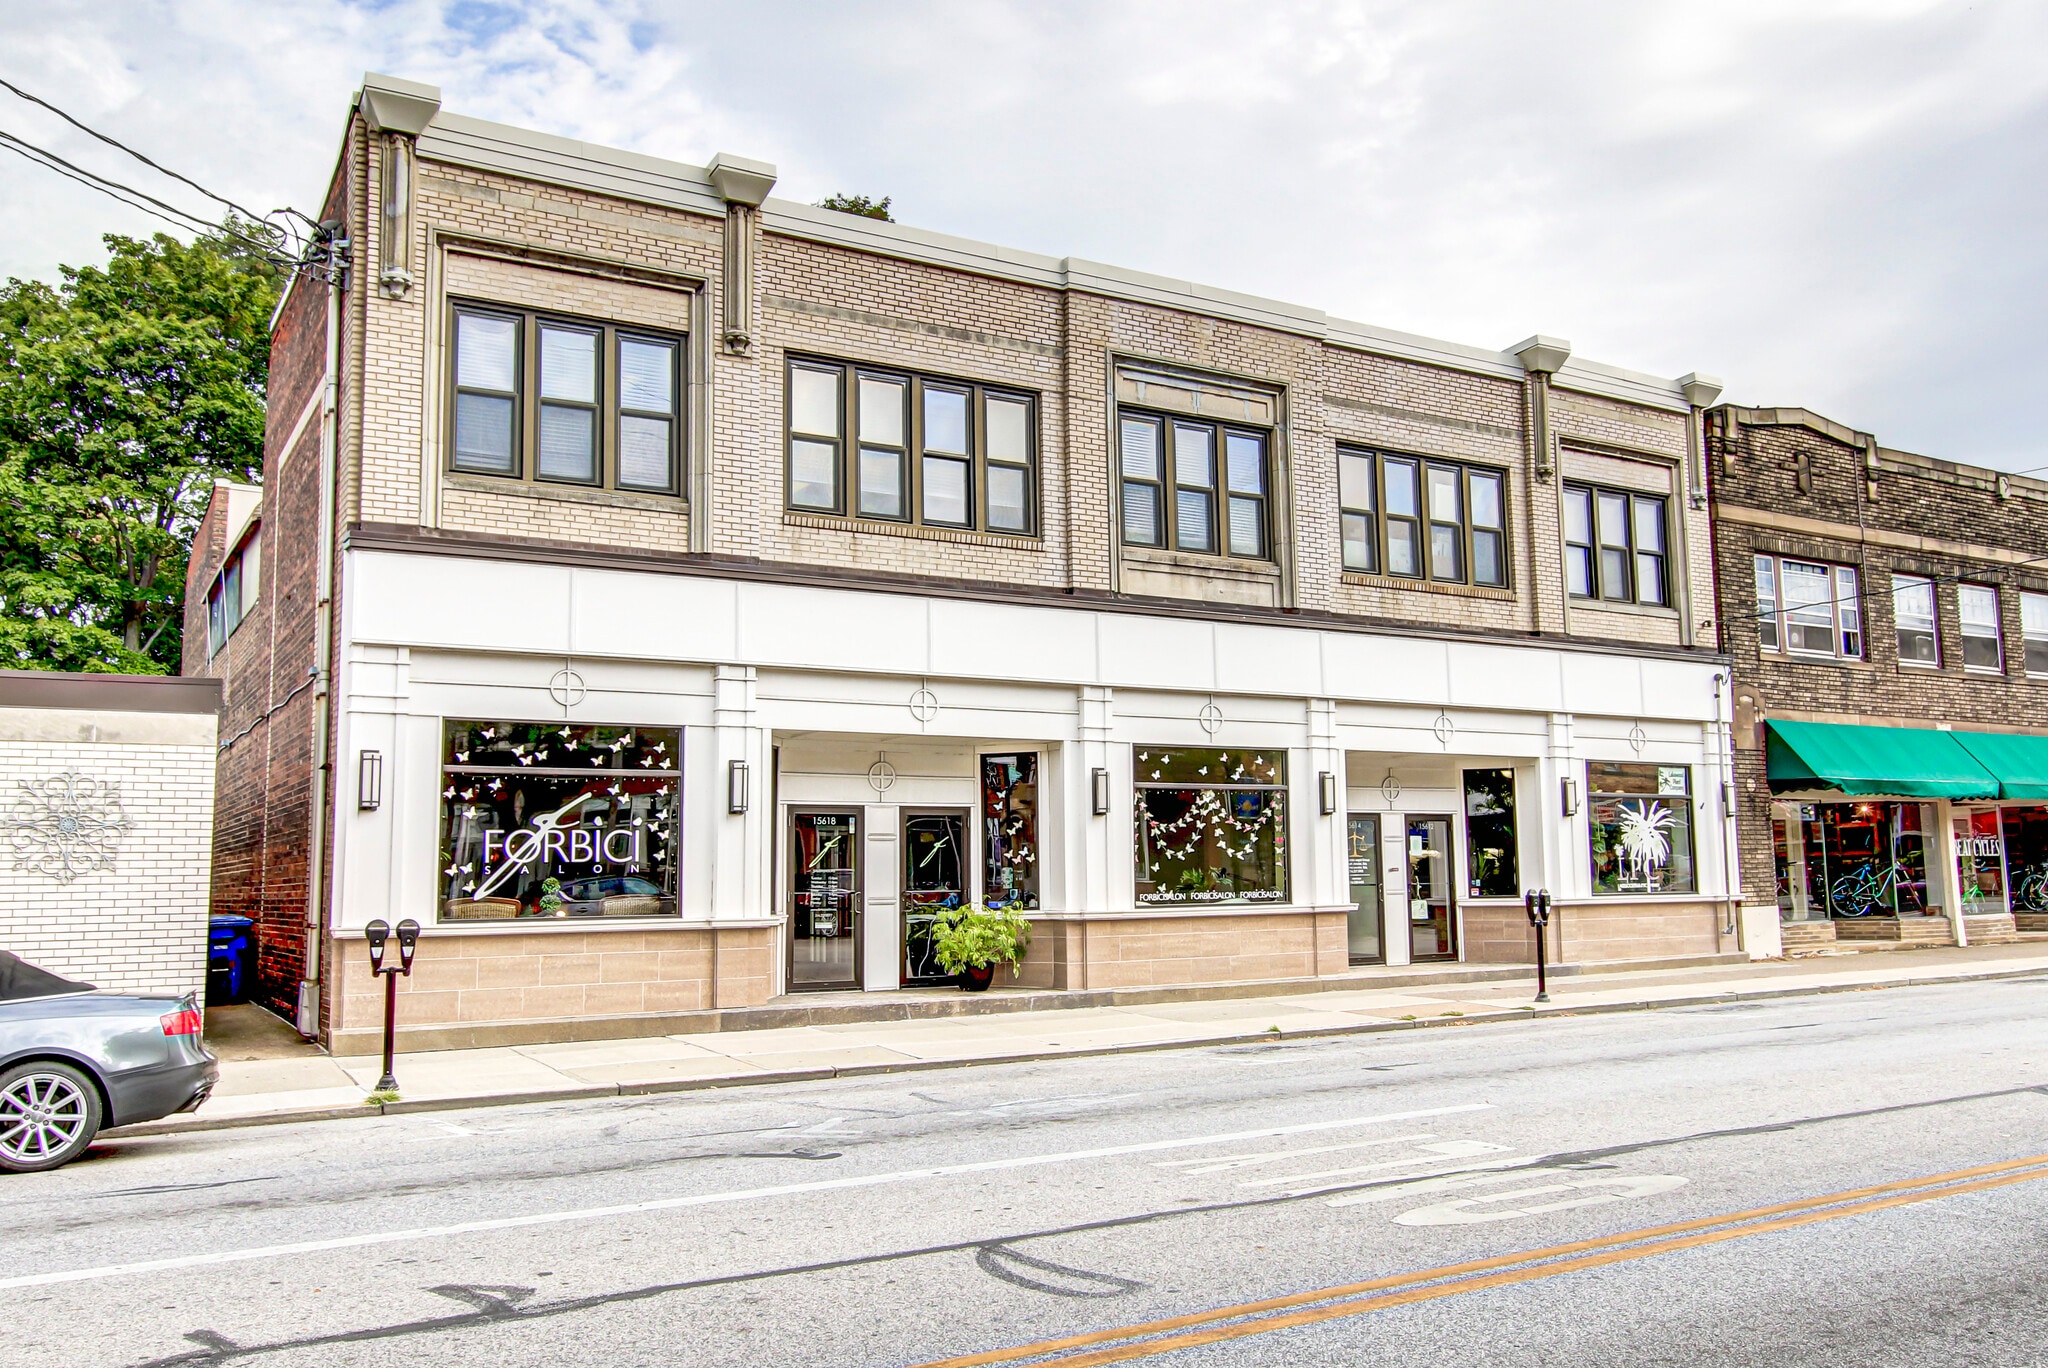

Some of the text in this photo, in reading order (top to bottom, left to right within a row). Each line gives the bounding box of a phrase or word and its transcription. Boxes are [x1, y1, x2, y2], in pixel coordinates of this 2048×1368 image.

[813, 816, 836, 825] 15618
[1973, 839, 2000, 857] CYCLES
[485, 865, 640, 875] SALON
